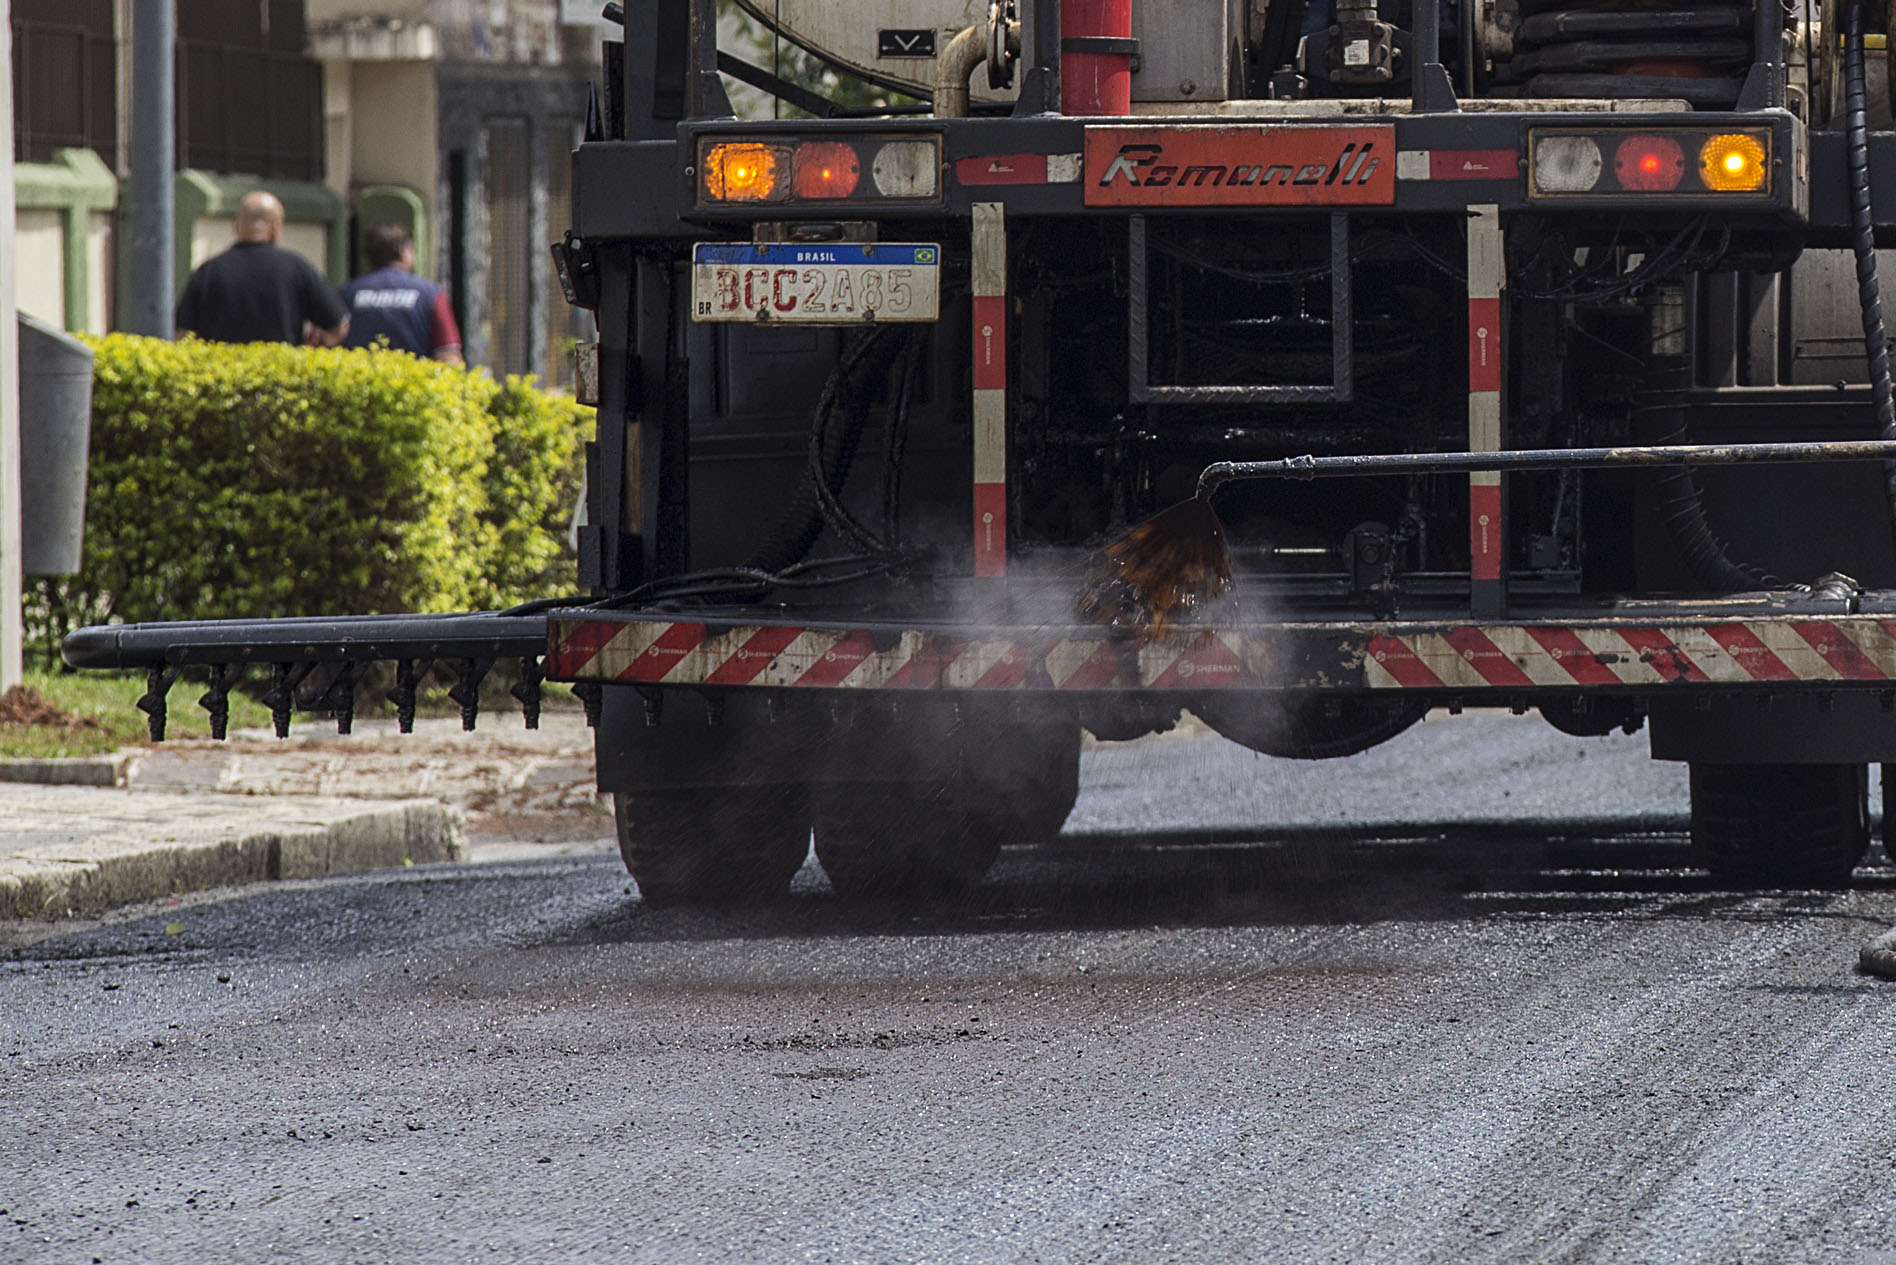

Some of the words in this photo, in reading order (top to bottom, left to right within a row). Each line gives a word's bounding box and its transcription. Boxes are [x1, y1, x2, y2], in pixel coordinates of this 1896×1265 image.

[1099, 142, 1381, 187] Romanelli
[796, 252, 837, 263] BRASIL
[716, 268, 912, 313] BCC2A85
[698, 301, 712, 315] BR
[1195, 662, 1241, 674] SHERMAN
